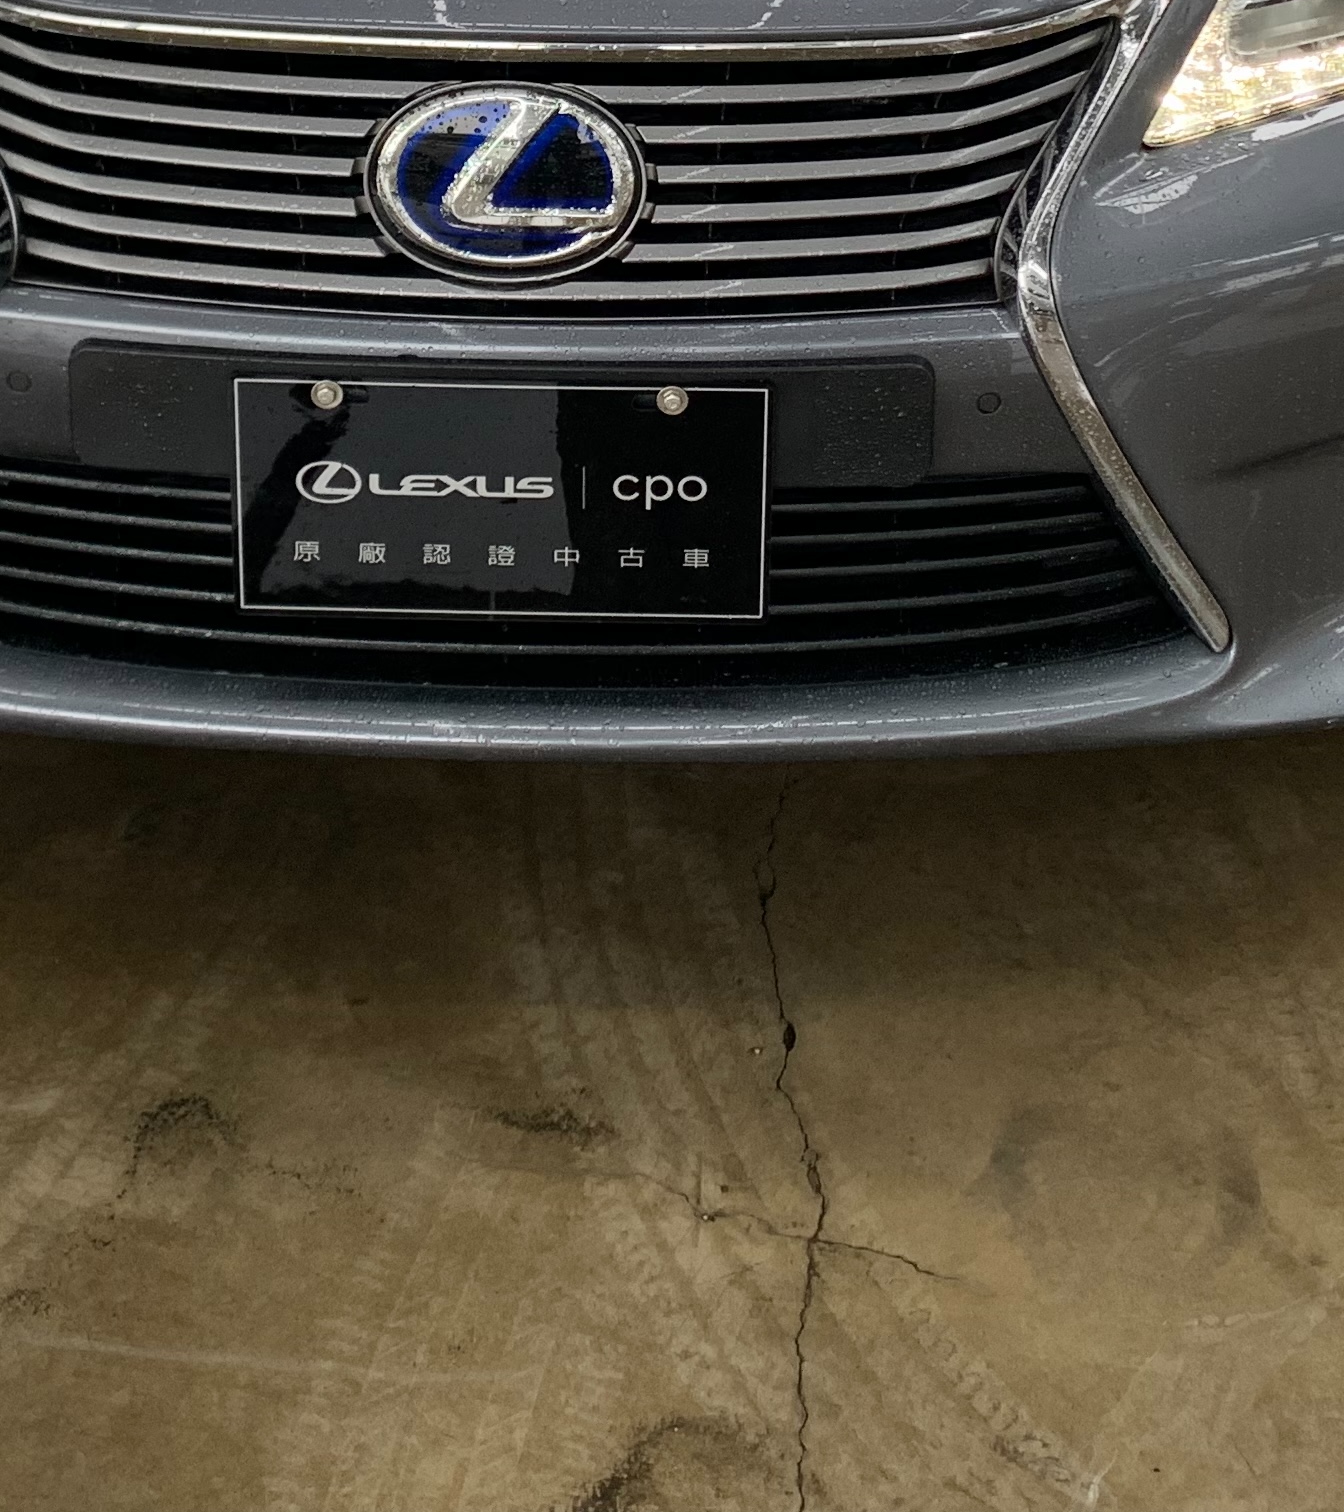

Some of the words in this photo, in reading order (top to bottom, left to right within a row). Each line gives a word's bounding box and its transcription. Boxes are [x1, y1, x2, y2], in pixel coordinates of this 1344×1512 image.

[368, 473, 554, 498] LEXUS
[612, 474, 708, 511] cpo
[293, 540, 710, 569] 原廠認證中古車
